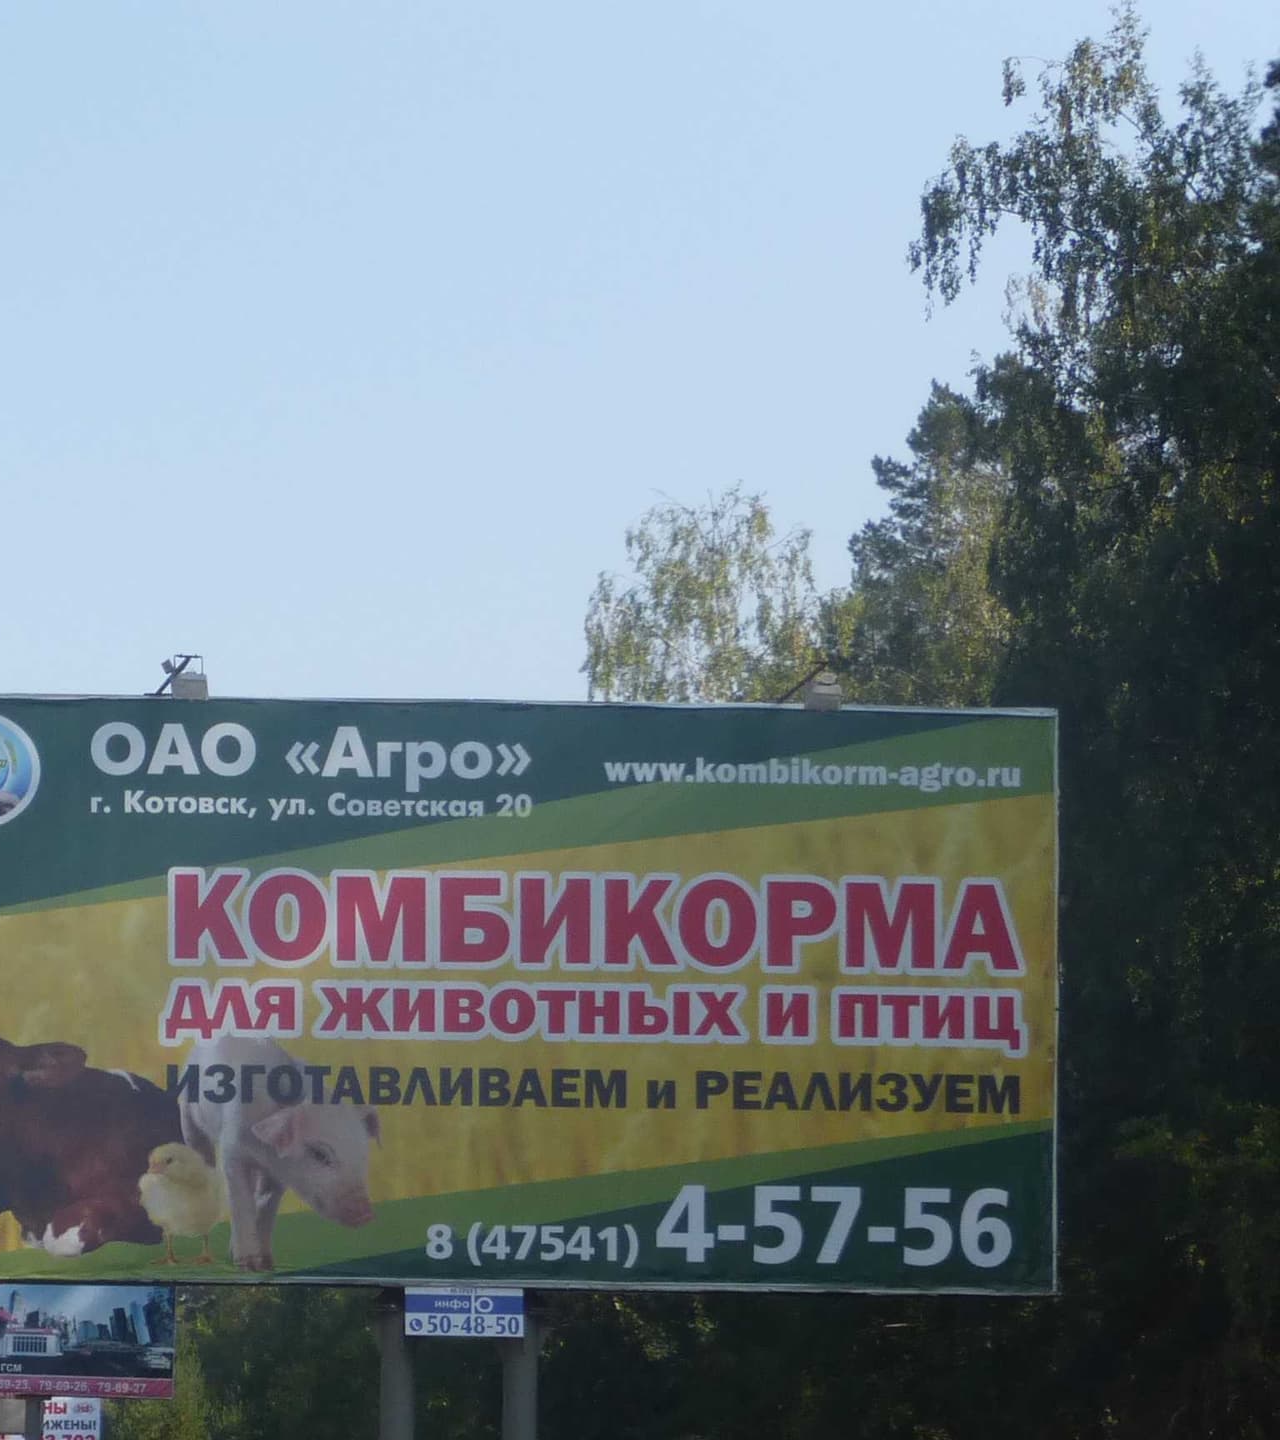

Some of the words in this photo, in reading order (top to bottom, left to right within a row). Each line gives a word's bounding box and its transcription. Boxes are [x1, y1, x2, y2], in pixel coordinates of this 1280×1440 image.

[90, 721, 257, 777] ОАО
[284, 725, 533, 793] «Агро»
[603, 757, 1021, 793] www.kombikorm-agro.ru
[90, 797, 111, 815] г.
[124, 790, 256, 820] Котовск,
[269, 795, 316, 821] ул.
[327, 793, 485, 818] Советская
[496, 794, 532, 818] 20
[170, 868, 1021, 972] КОМБИКОРМА
[164, 984, 296, 1040] ДЛЯ
[319, 987, 742, 1038] ЖИВОТНЫХ
[838, 993, 1021, 1051] ПТИЦ
[165, 1063, 628, 1110] ИЗГОТАВЛИВАЕМ
[694, 1070, 1021, 1115] РЕАЛИЗУЕМ
[424, 1222, 454, 1261] 8
[466, 1221, 639, 1268] (47541)
[655, 1183, 1015, 1268] 4-57-56
[427, 1315, 520, 1335] 50-48-50
[0, 1363, 23, 1373] ГСМ
[42, 1402, 67, 1415] НЫ
[43, 1419, 97, 1431] ИЖЕНЫ!
